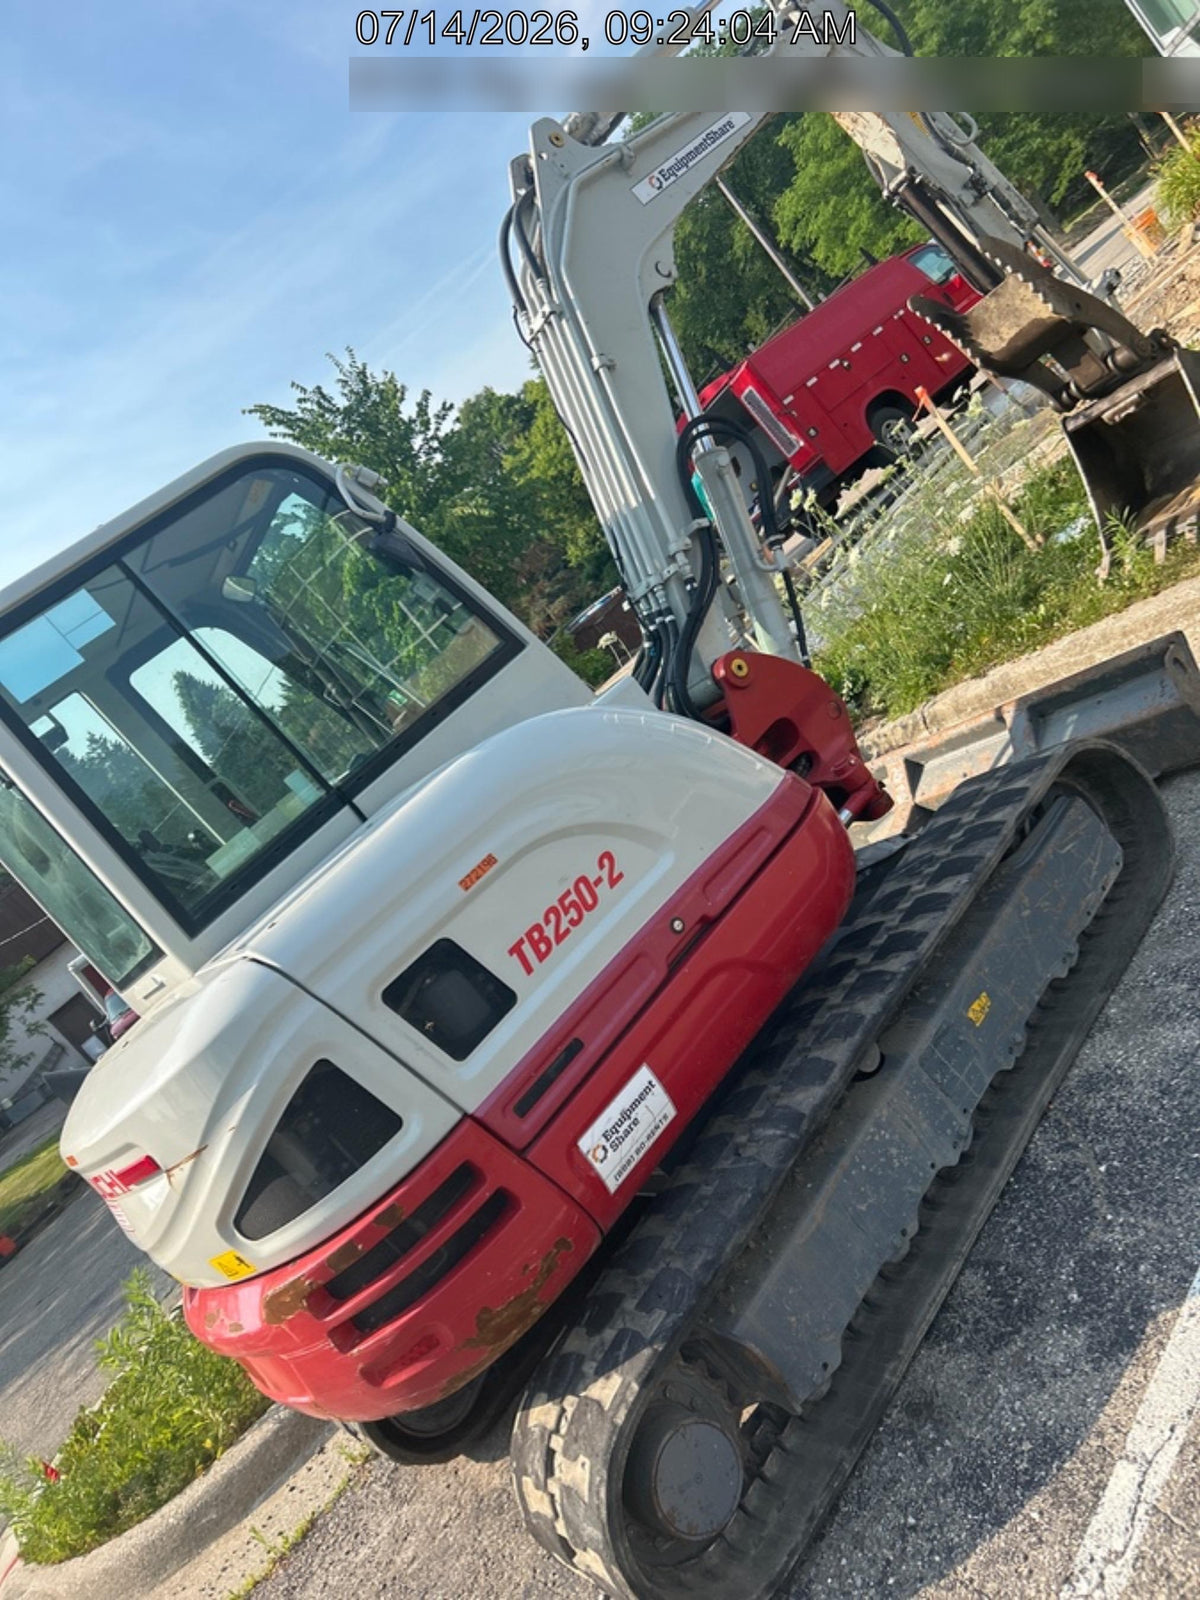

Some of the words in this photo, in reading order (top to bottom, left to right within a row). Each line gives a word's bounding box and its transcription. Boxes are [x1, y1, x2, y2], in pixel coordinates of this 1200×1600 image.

[658, 119, 735, 182] EquipmentShare
[507, 850, 625, 977] TB250-2
[601, 1080, 656, 1143] Equipment
[609, 1116, 640, 1153] Share
